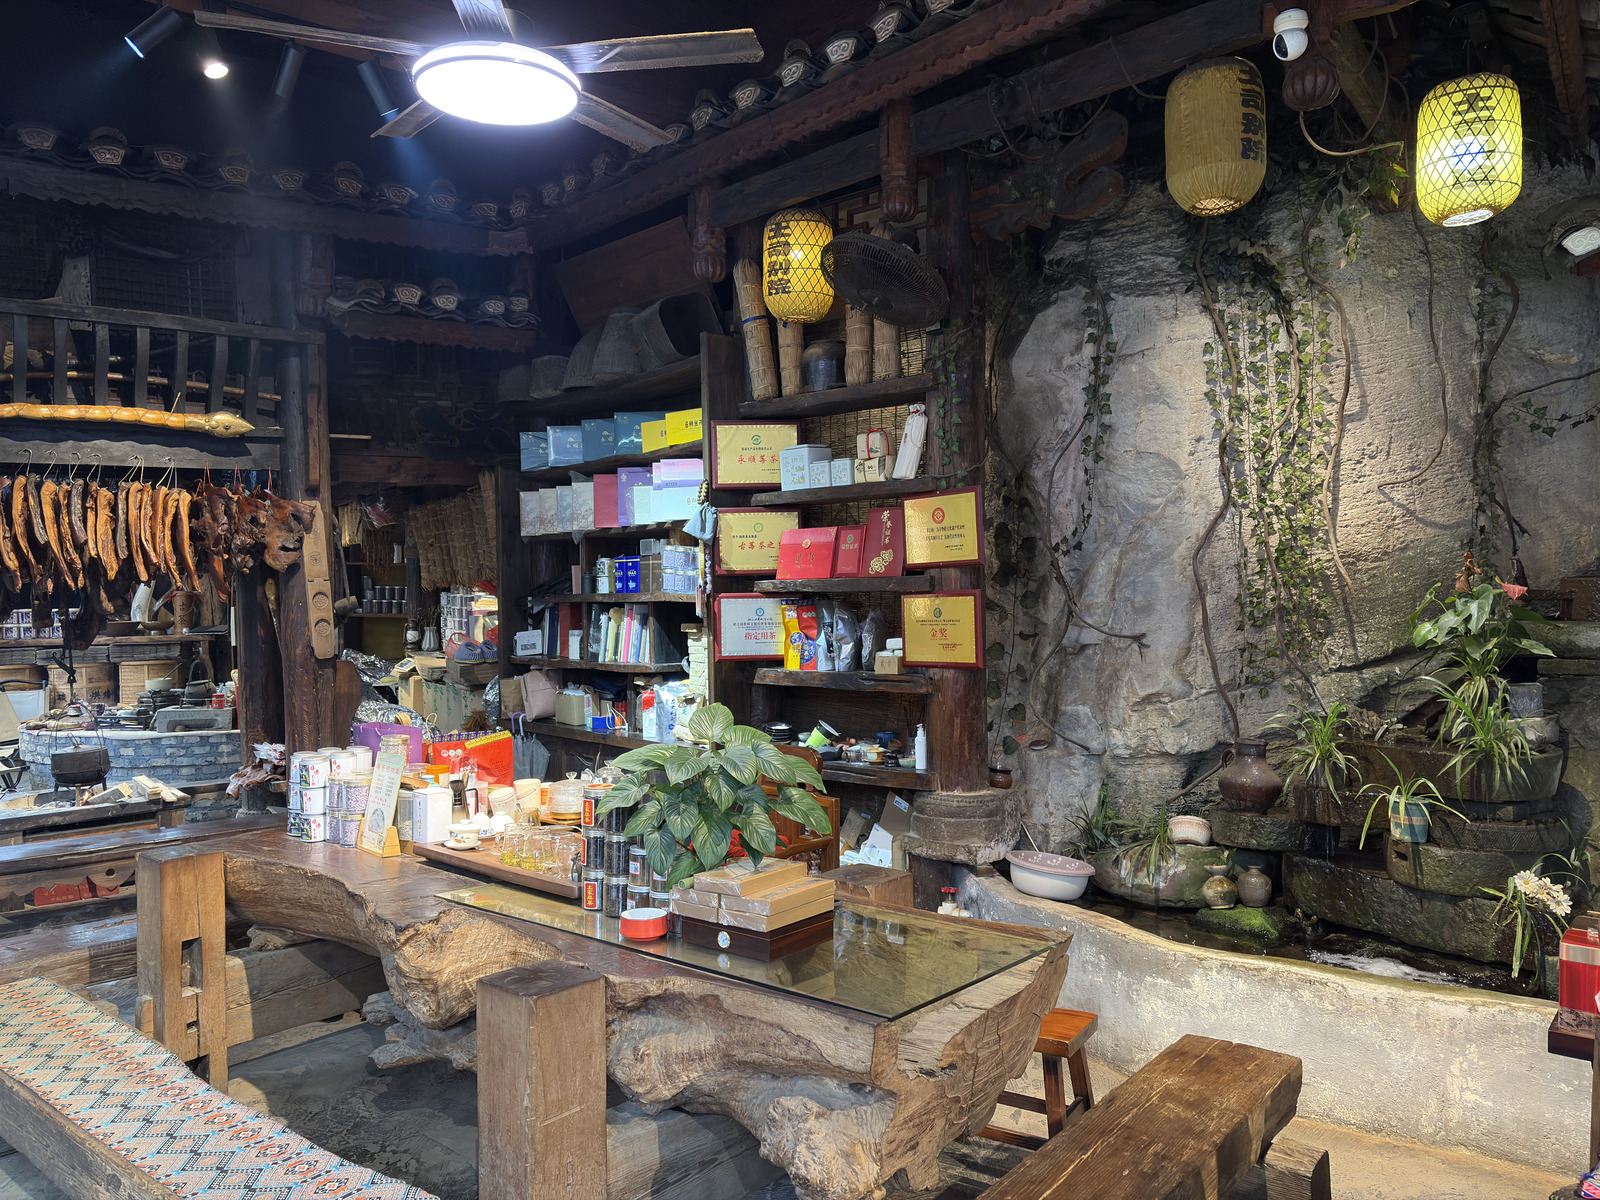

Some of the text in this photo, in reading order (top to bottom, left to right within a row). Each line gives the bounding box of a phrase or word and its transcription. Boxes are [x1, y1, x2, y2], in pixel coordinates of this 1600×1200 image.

[1451, 92, 1497, 190] 土司院
[738, 541, 781, 550] 古莓茶之
[744, 631, 777, 641] 指定用茶
[930, 627, 948, 638] 金奖
